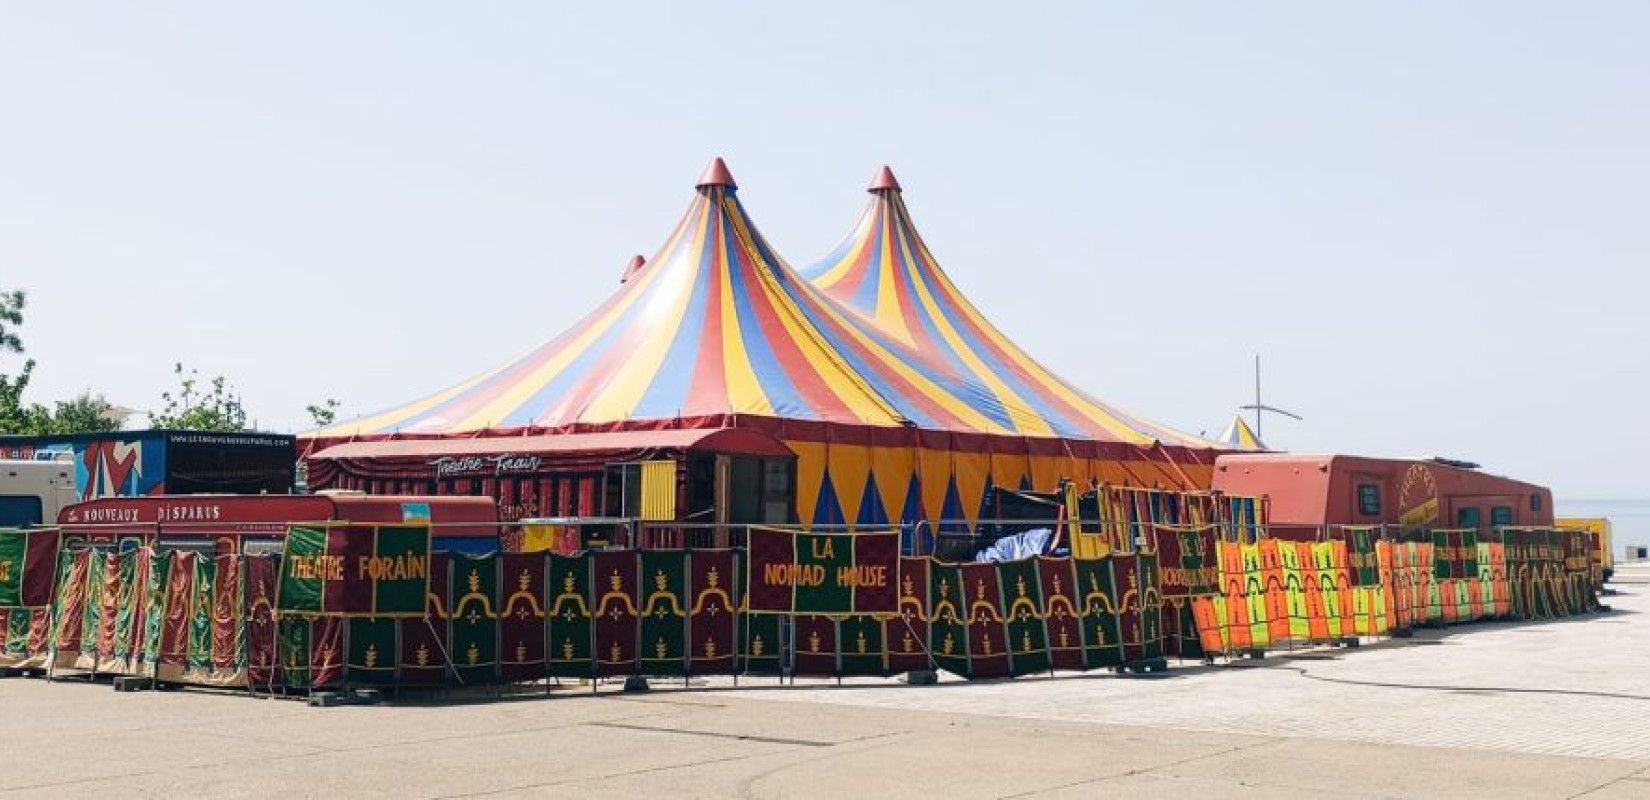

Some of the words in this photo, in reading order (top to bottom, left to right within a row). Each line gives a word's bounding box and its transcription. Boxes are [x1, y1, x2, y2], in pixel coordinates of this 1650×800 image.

[83, 508, 139, 522] NOUVEAUX
[812, 537, 834, 559] LA
[765, 563, 825, 587] NOMAD
[837, 565, 887, 587] HOUSE
